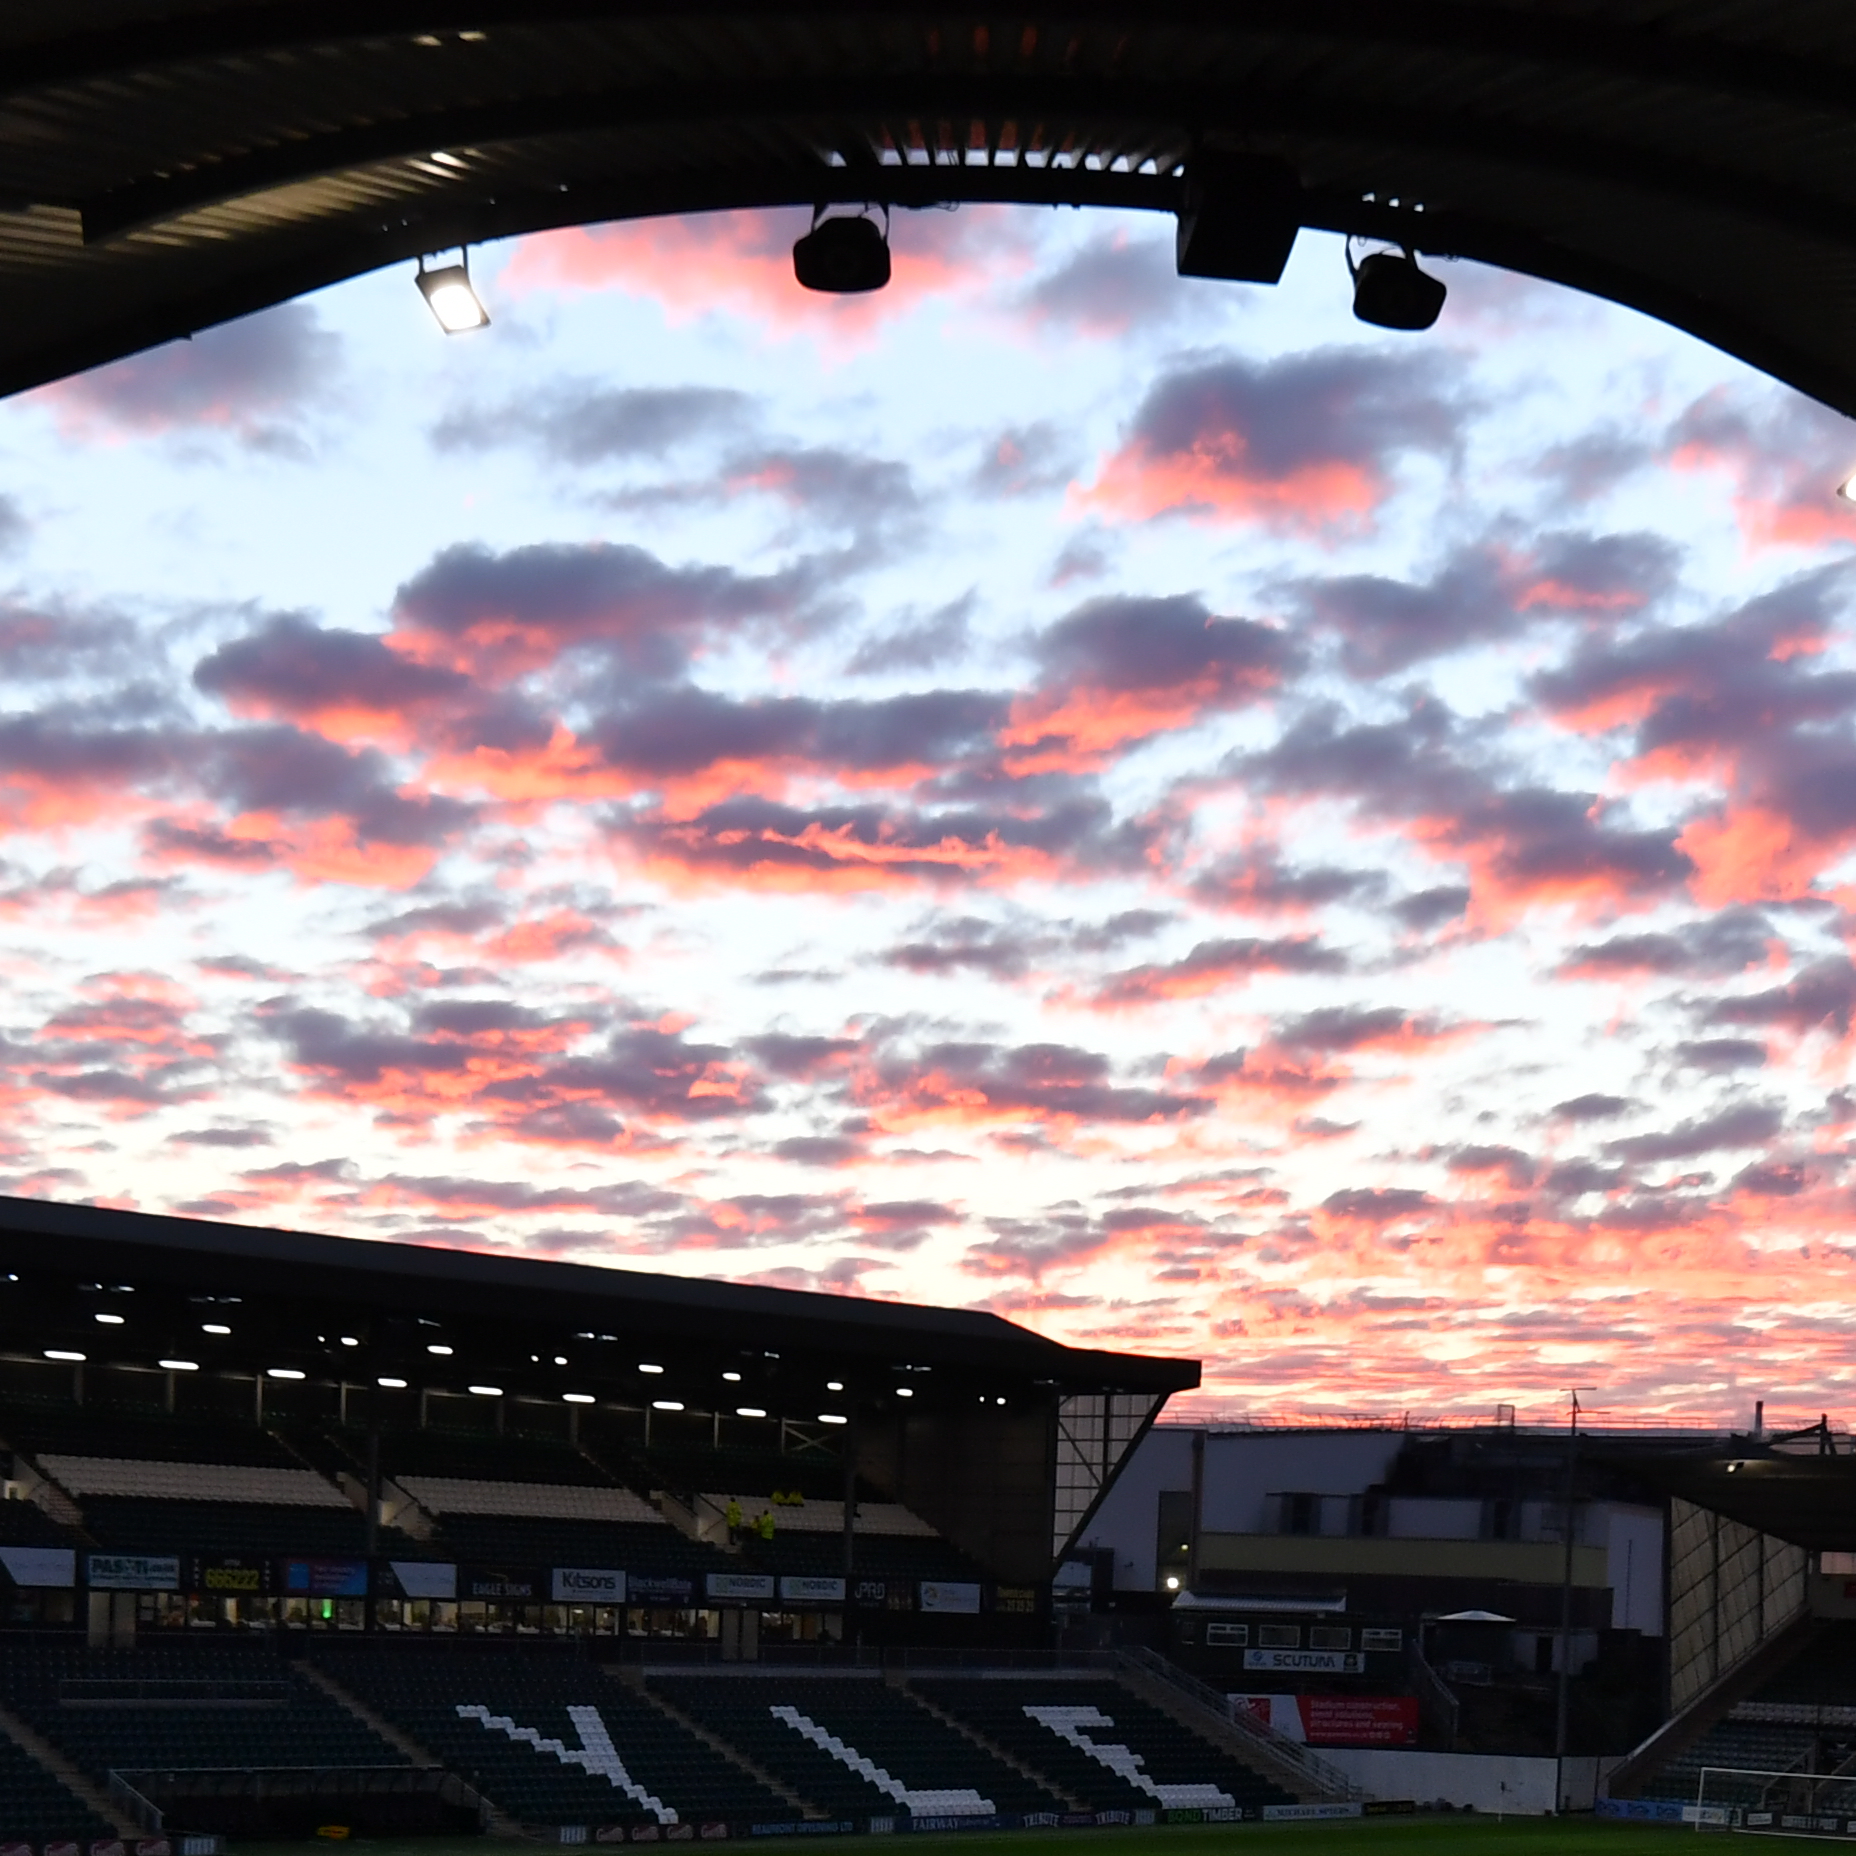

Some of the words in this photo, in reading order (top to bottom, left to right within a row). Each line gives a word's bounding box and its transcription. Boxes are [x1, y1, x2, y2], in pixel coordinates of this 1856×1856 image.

[562, 1571, 616, 1589] Kitsons
[729, 1577, 766, 1588] NORDIC
[1273, 1653, 1336, 1668] SCUTUM
[1022, 1811, 1060, 1828] TRIBUTE
[1094, 1810, 1132, 1826] TRIBUTE
[1202, 1807, 1243, 1822] TIMBER
[913, 1816, 959, 1831] FAIRWAY
